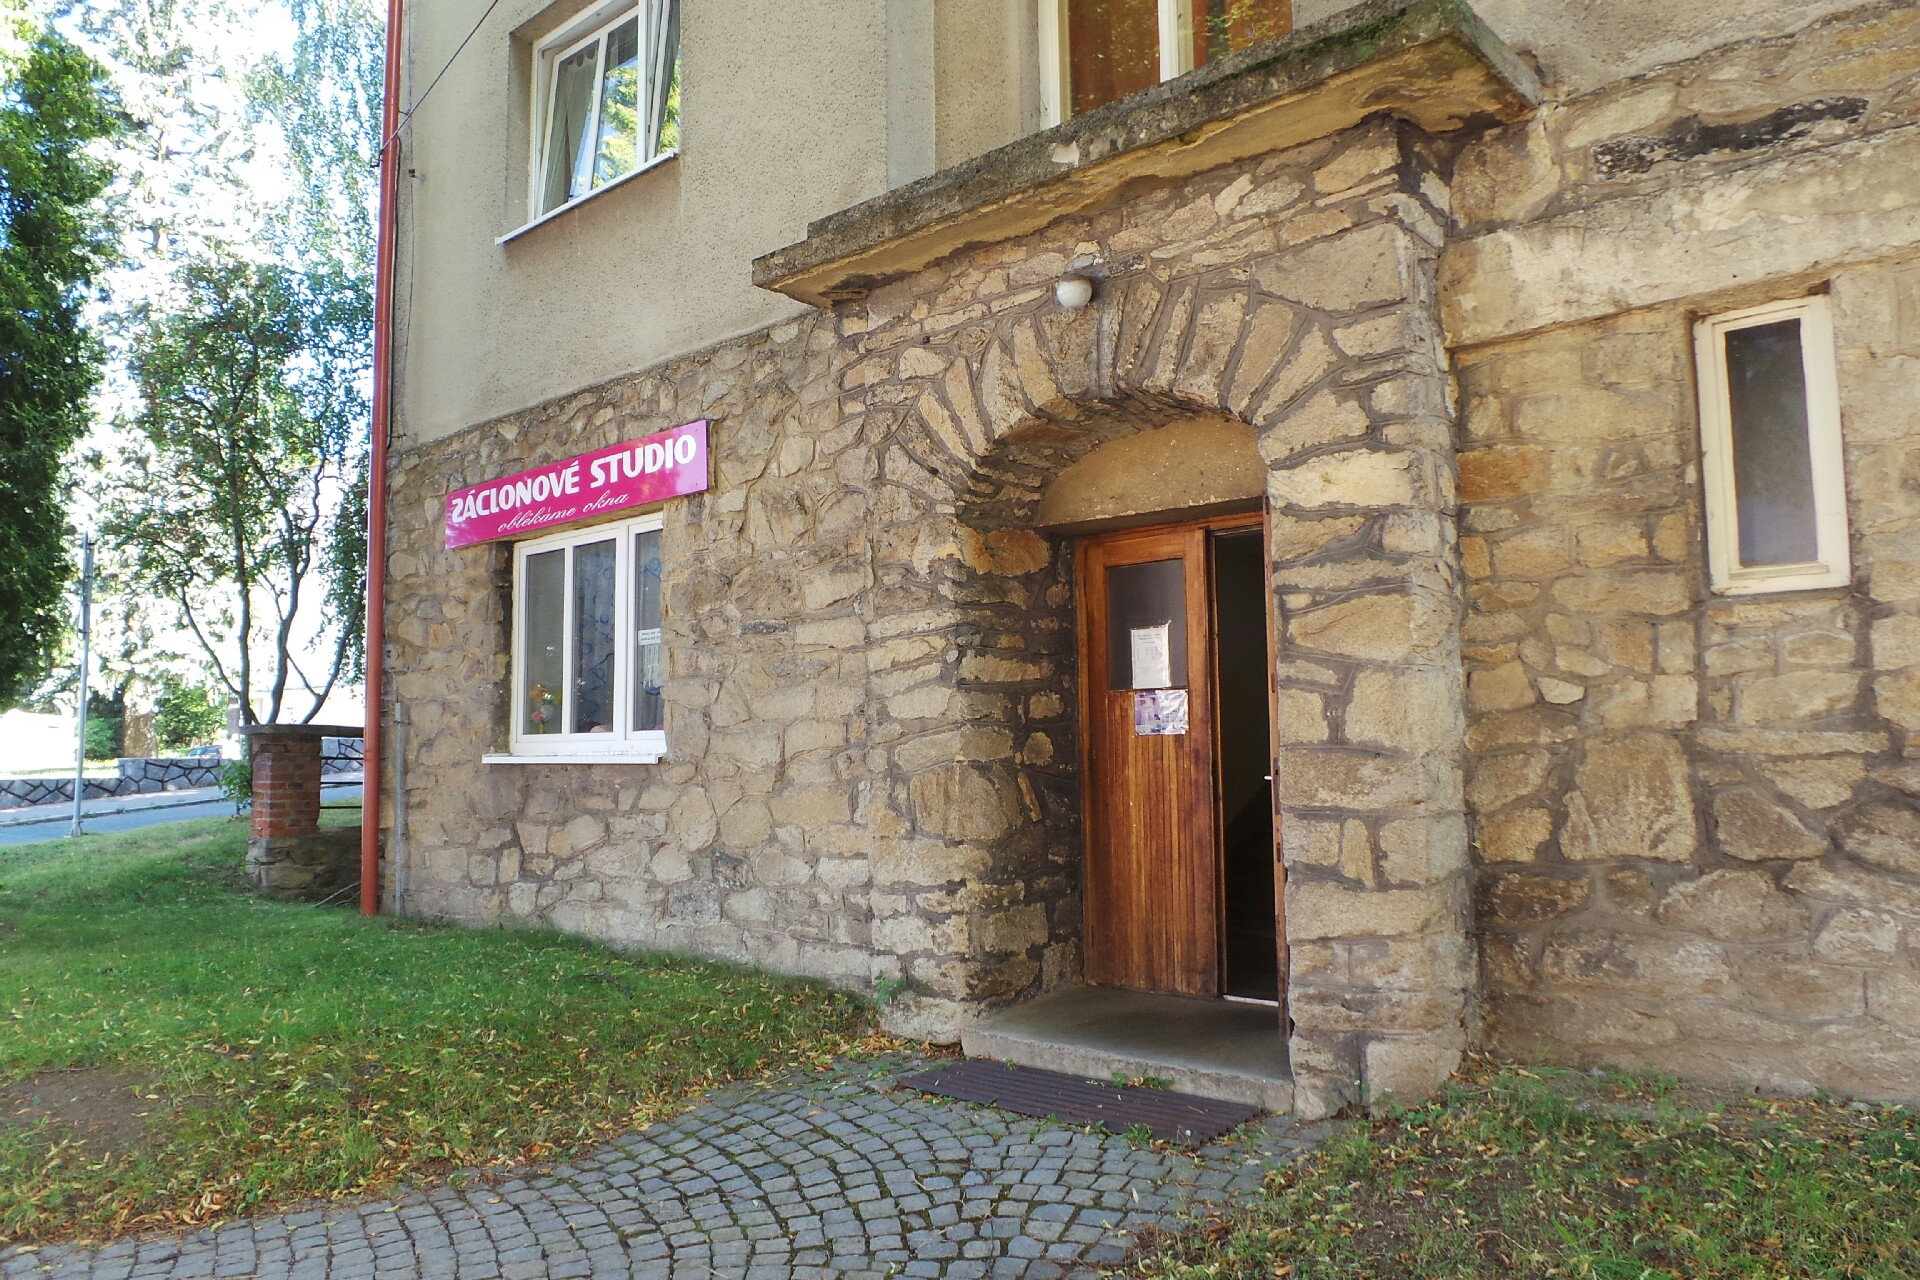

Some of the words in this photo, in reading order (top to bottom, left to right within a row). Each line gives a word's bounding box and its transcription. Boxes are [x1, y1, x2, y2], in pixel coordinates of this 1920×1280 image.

[451, 460, 580, 523] ZÁCLONOVÉ
[590, 434, 697, 488] STUDIO
[497, 506, 576, 532] oblékáme
[582, 489, 629, 513] okna
